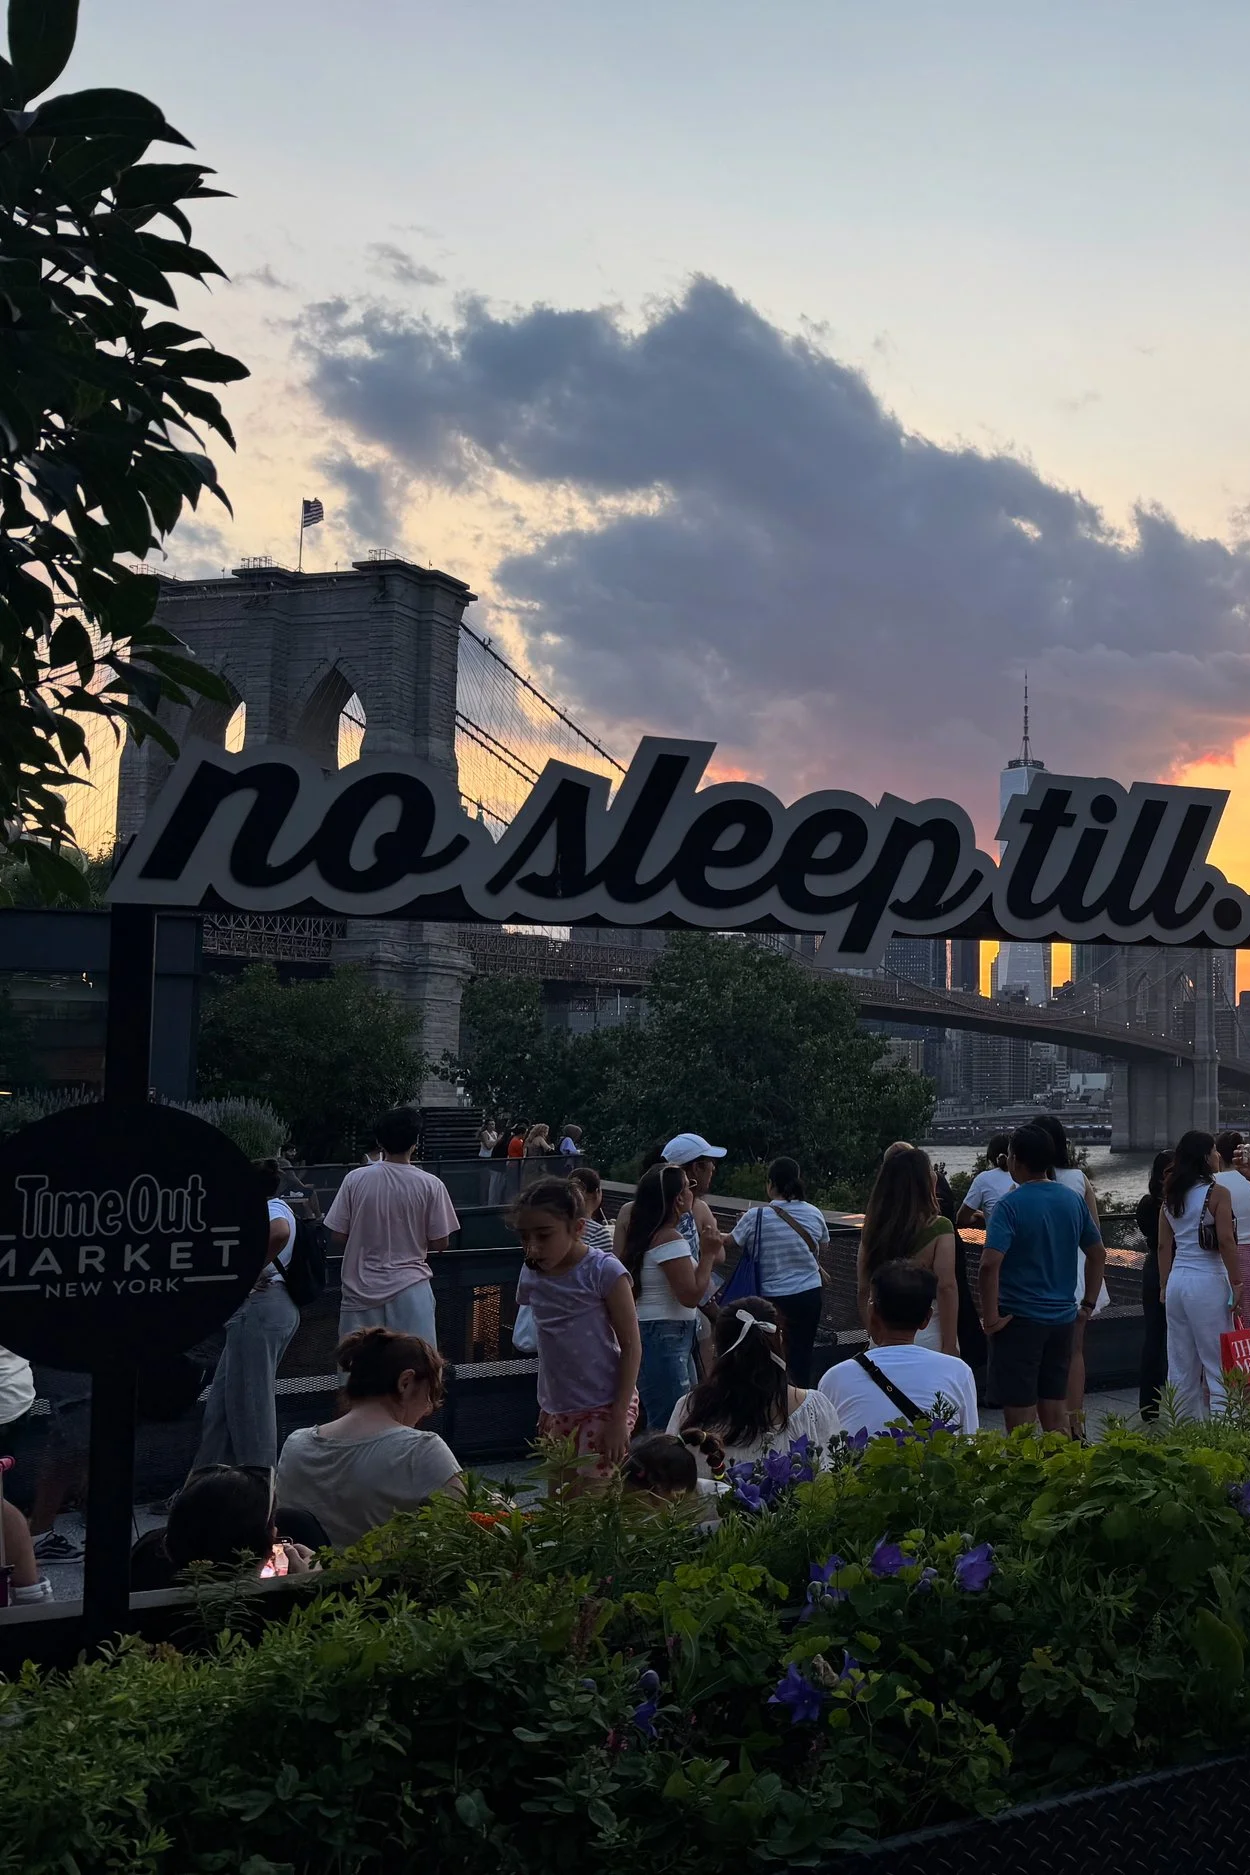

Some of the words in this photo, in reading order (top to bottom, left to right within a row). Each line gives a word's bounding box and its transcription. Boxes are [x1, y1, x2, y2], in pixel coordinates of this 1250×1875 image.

[138, 759, 470, 895] no
[485, 753, 984, 954] sleep
[45, 1280, 103, 1299] NEW
[112, 1277, 181, 1296] YORK
